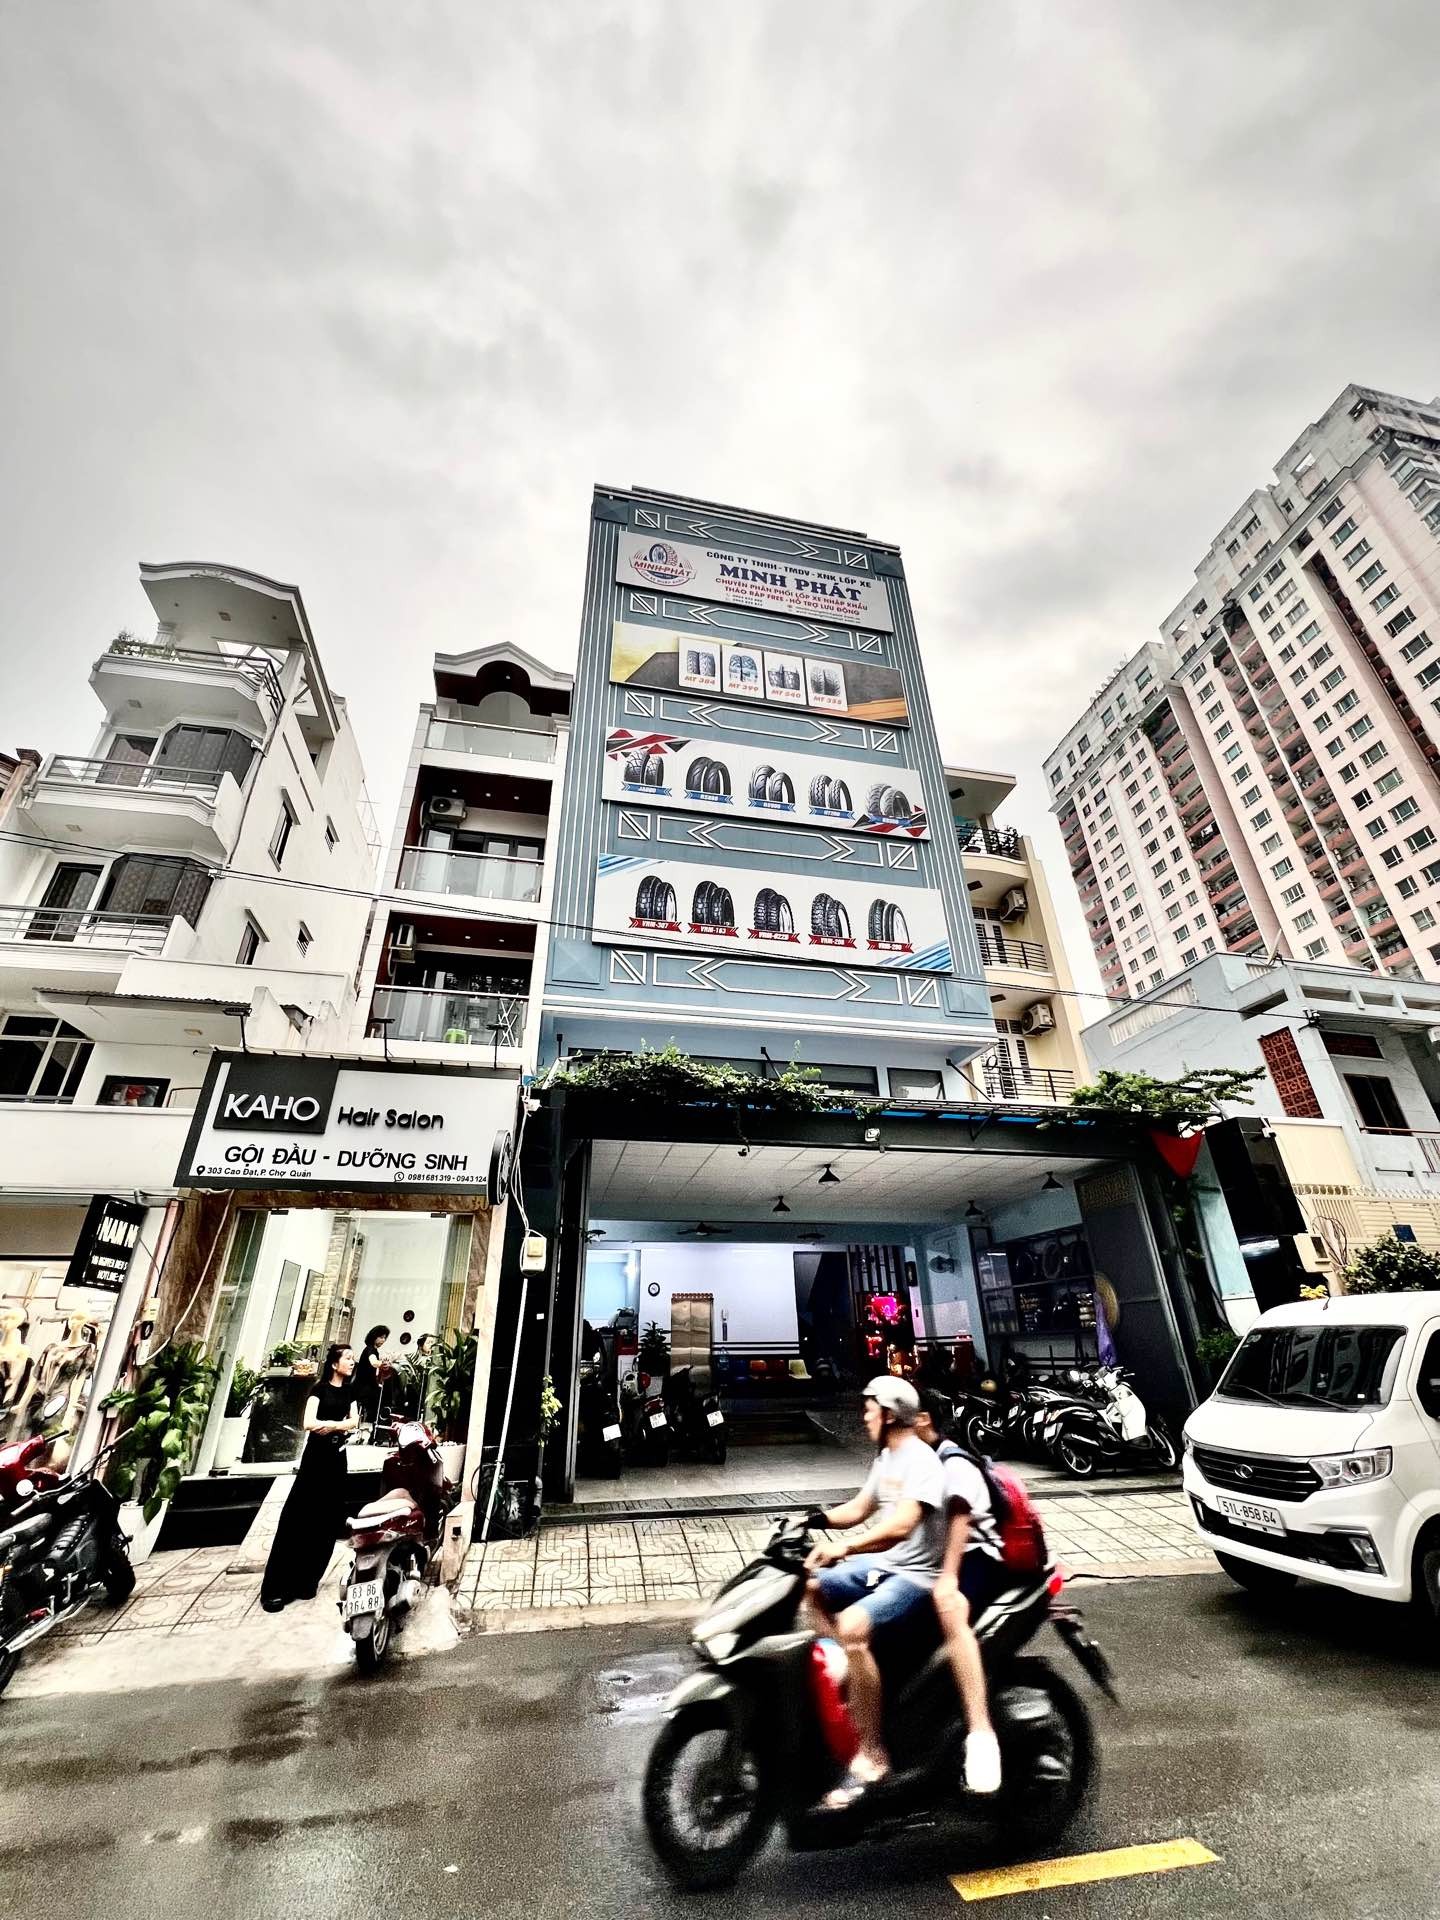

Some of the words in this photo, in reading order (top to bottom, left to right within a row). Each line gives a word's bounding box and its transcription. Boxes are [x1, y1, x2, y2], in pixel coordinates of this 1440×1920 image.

[706, 551, 734, 562] CÔNG
[737, 557, 748, 565] TY
[751, 560, 777, 570] TNHH
[817, 572, 836, 582] XNK
[719, 563, 787, 588] MINH
[794, 577, 861, 601] PHÁT
[223, 1093, 320, 1121] KAHO
[337, 1106, 380, 1128] Hair
[384, 1109, 444, 1129] Salon
[224, 1144, 264, 1167] GỘI
[272, 1143, 316, 1165] ĐẦU
[337, 1148, 416, 1169] DƯỠNG
[424, 1153, 468, 1171] SINH
[207, 1167, 222, 1175] 303
[224, 1167, 241, 1175] Cao
[268, 1169, 287, 1178] Chợ
[1222, 1500, 1276, 1524] 51L-858.64
